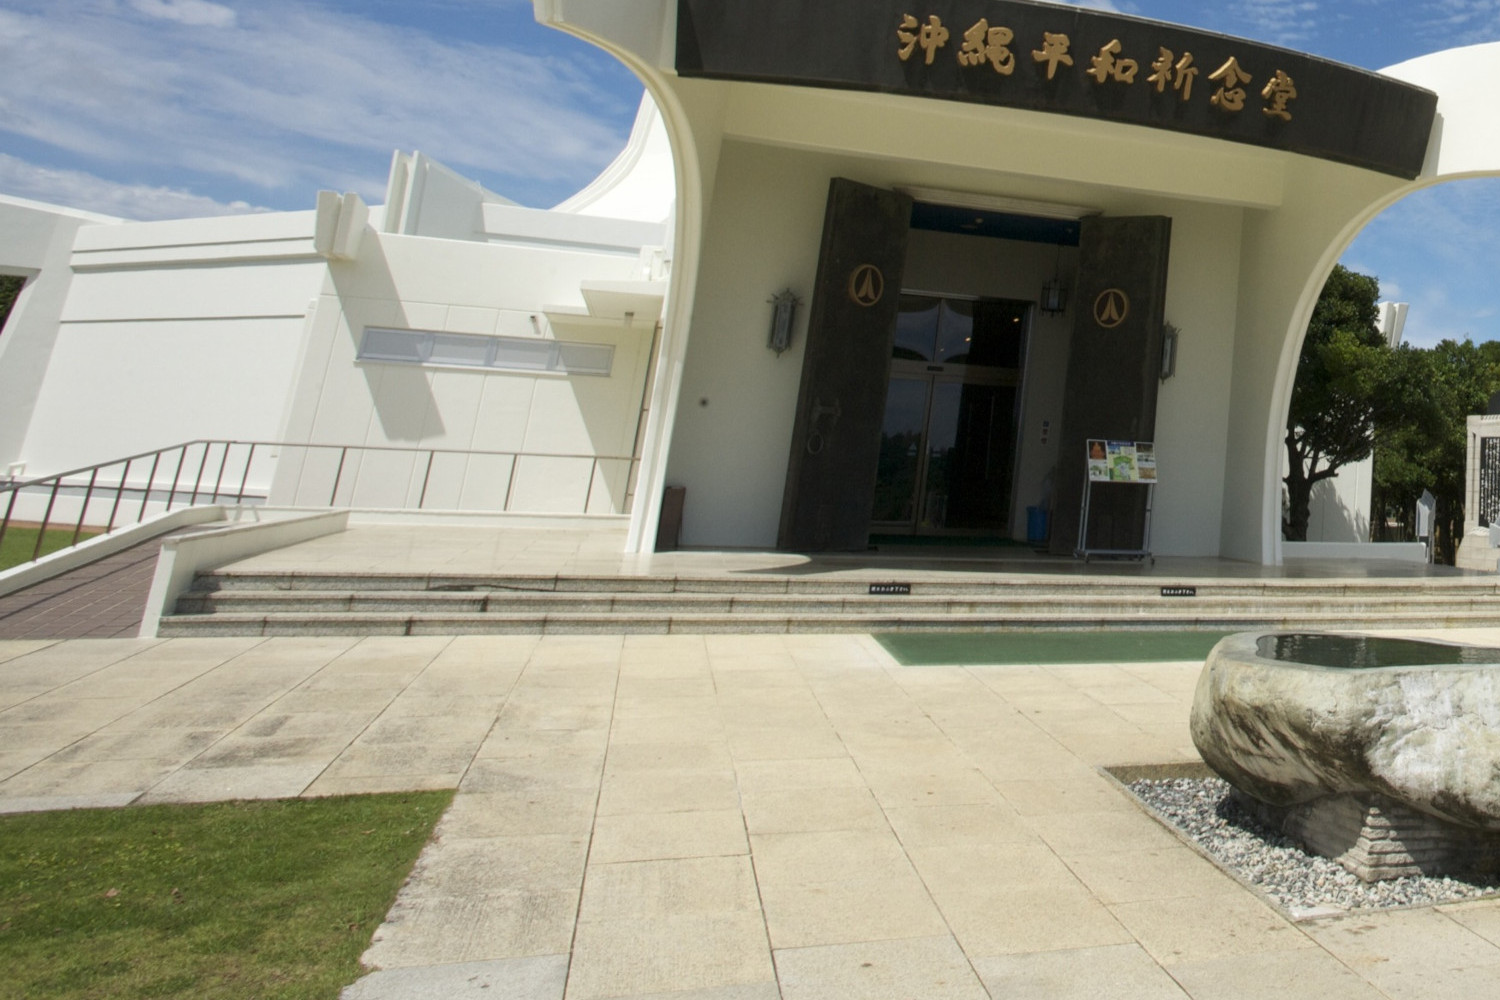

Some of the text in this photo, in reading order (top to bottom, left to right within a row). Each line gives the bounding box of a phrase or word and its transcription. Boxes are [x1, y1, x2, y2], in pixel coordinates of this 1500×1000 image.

[897, 14, 1298, 121] 沖縄平和祈念堂
